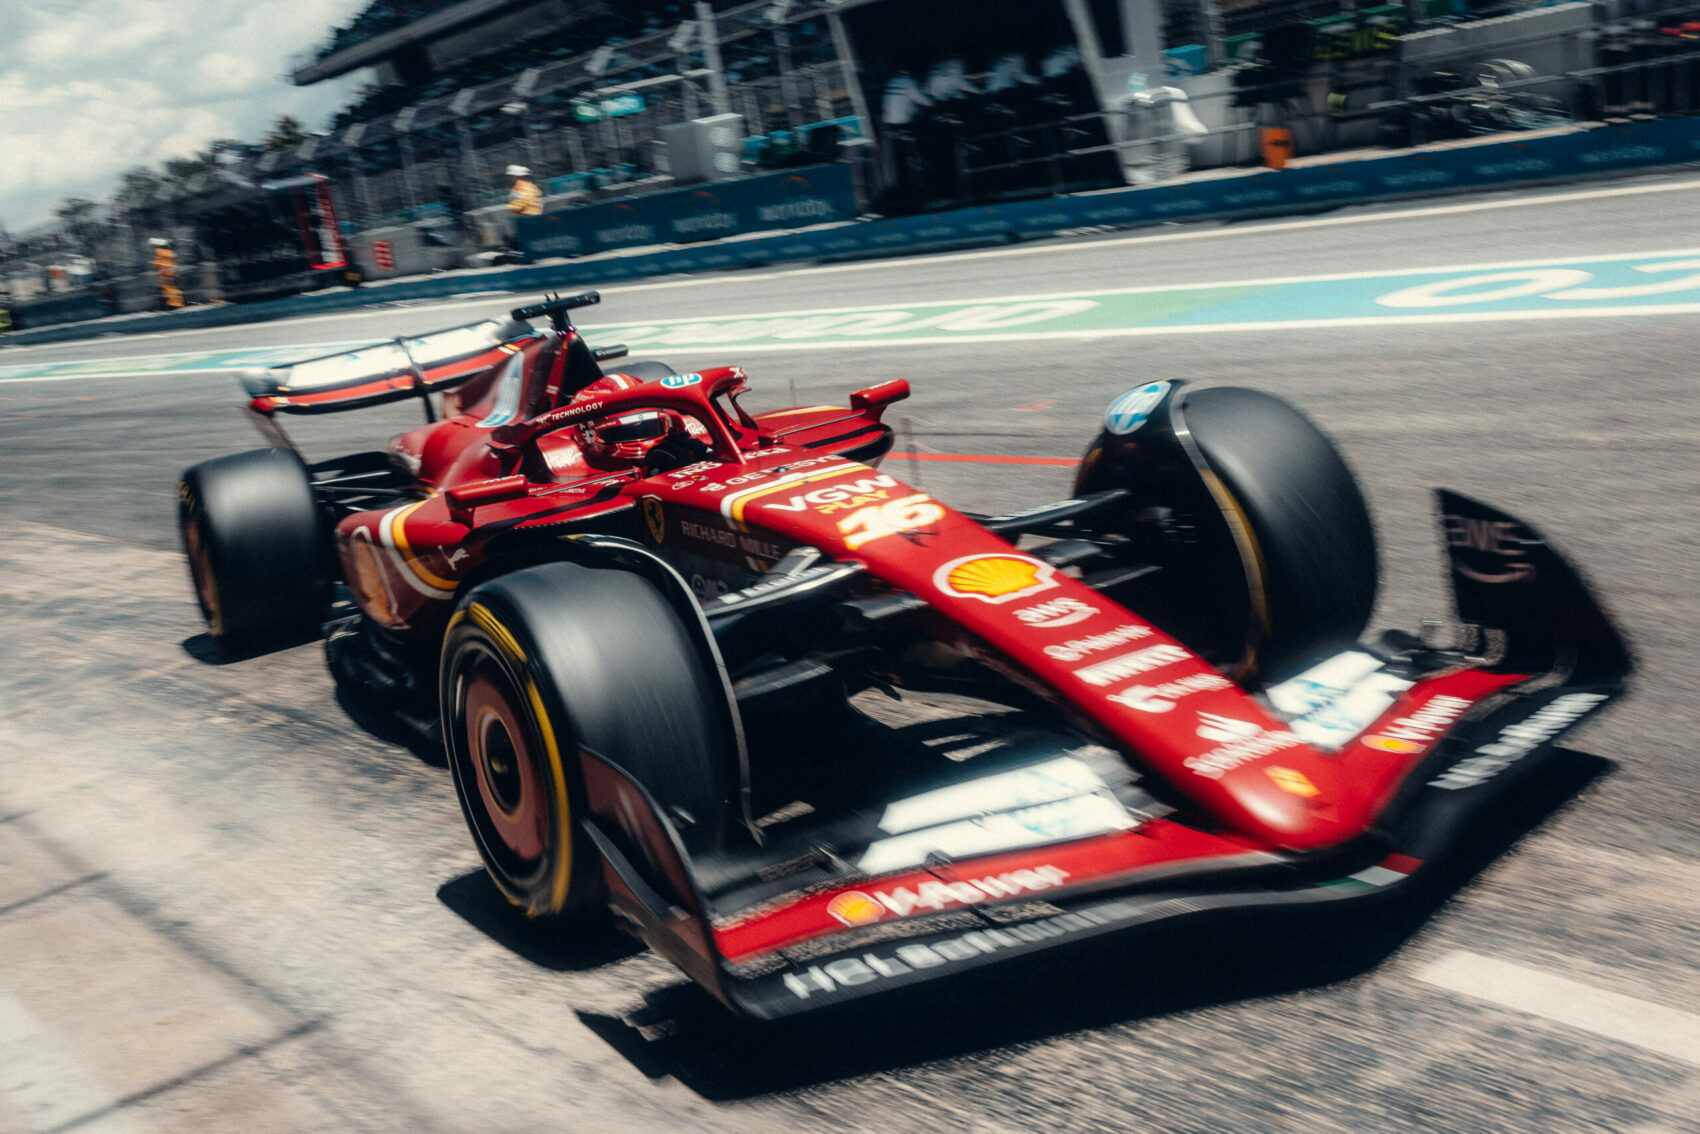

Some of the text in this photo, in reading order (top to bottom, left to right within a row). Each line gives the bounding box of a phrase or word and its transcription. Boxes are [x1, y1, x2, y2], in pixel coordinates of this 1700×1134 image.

[664, 374, 698, 388] hp
[551, 401, 603, 421] TECHNOLOGY
[763, 475, 898, 511] VGW
[814, 490, 889, 514] PLAY
[836, 494, 946, 550] 16
[681, 520, 782, 560] RICHARD MILLE
